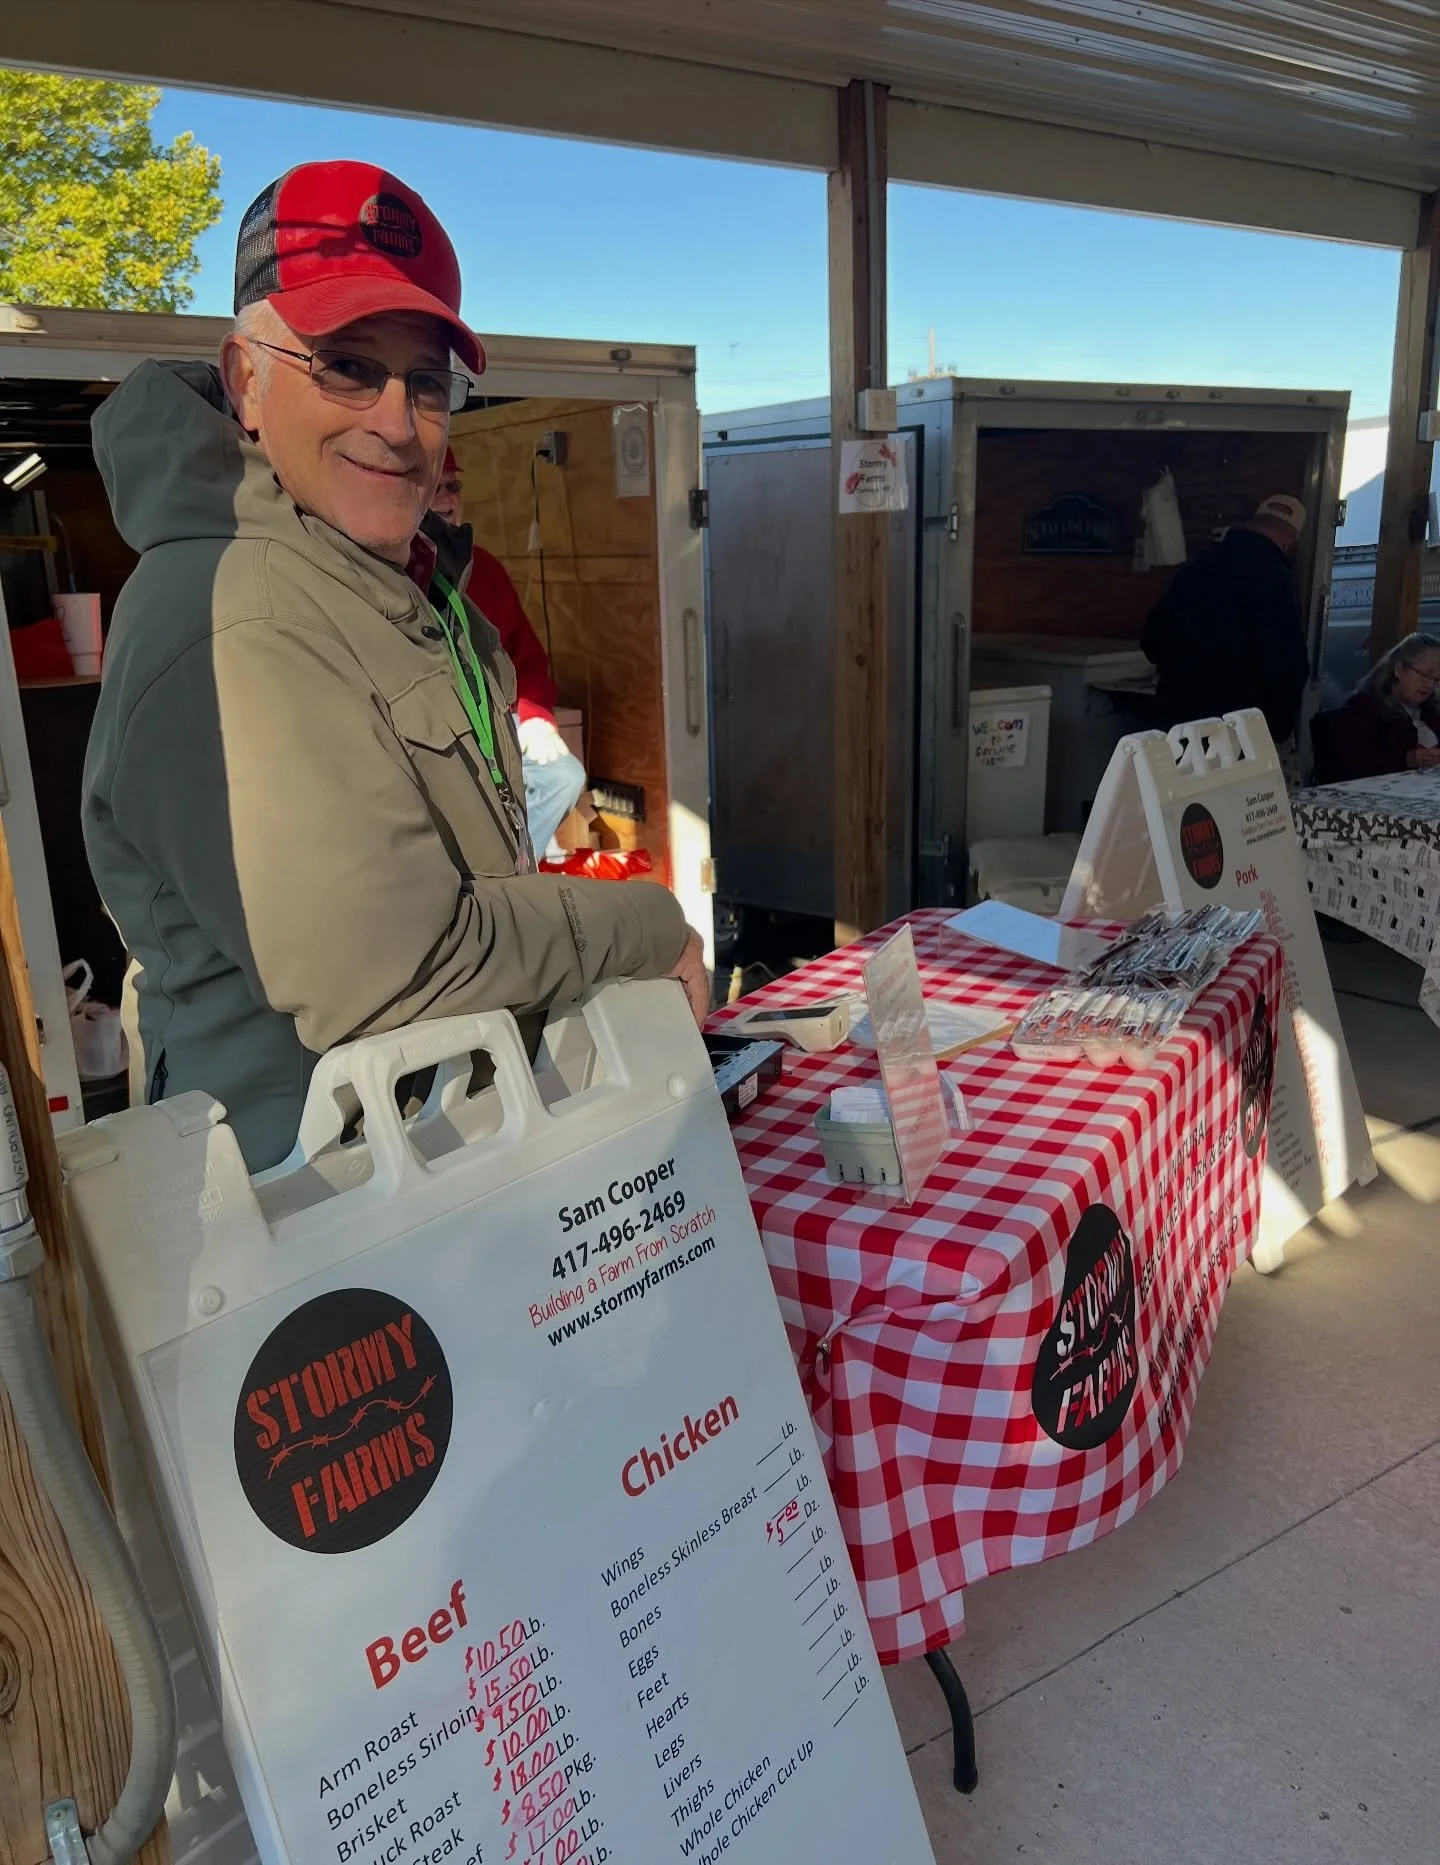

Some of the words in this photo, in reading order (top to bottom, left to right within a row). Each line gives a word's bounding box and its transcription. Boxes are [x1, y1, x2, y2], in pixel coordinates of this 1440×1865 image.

[1235, 864, 1258, 887] Pork
[552, 1190, 686, 1280] 417-496-2469
[558, 1196, 606, 1232] Sam
[607, 1157, 676, 1206] Cooper
[528, 1283, 584, 1328] Building
[587, 1277, 598, 1293] a
[598, 1255, 635, 1286] Farm
[635, 1236, 668, 1265] From
[669, 1205, 717, 1244] Scratch
[547, 1236, 716, 1347] www.stormyfarms.com
[246, 1312, 417, 1449] STORMY
[620, 1395, 740, 1498] Chicken
[1056, 1324, 1137, 1434] FARMS
[291, 1412, 435, 1538] FARMS
[601, 1545, 646, 1588] Wings
[781, 1420, 798, 1441] Lb.
[610, 1561, 671, 1619] Boneless
[671, 1519, 722, 1570] Skinless
[721, 1485, 758, 1526] Breast
[789, 1447, 805, 1467] Lb.
[619, 1605, 663, 1649] Bones
[796, 1473, 812, 1493] Lb.
[628, 1644, 660, 1680] Eggs
[803, 1498, 821, 1519] Dz.
[636, 1671, 670, 1709] Feet
[811, 1524, 828, 1544] Lb.
[364, 1578, 469, 1690] Beef
[645, 1691, 690, 1740] Hearts
[819, 1554, 836, 1575] Lb.
[654, 1732, 686, 1769] Legs
[825, 1576, 842, 1597] Lb.
[663, 1753, 703, 1799] Livers
[833, 1602, 849, 1622] Lb.
[319, 1757, 362, 1799] Arm
[364, 1711, 420, 1762] Roast
[521, 1616, 546, 1640] Lb.
[326, 1753, 418, 1831] Boneless
[419, 1705, 478, 1759] Sirloin
[530, 1645, 554, 1669] Lb.
[336, 1798, 408, 1864] Brisket
[538, 1674, 562, 1698] Lb.
[409, 1791, 462, 1843] Roast
[547, 1703, 571, 1727] Lb.
[556, 1732, 579, 1756] Lb.
[564, 1752, 597, 1785] Pkg.
[670, 1778, 715, 1829] Thighs
[840, 1628, 856, 1648] Lb.
[679, 1808, 723, 1857] Whole
[723, 1755, 773, 1811] Chicken
[846, 1651, 863, 1673] Lb.
[731, 1783, 777, 1837] Chicken
[777, 1764, 798, 1794] Cut
[798, 1739, 815, 1766] Up
[854, 1673, 871, 1694] Lb.
[572, 1789, 596, 1813] Lb.
[581, 1818, 604, 1842] Lb.
